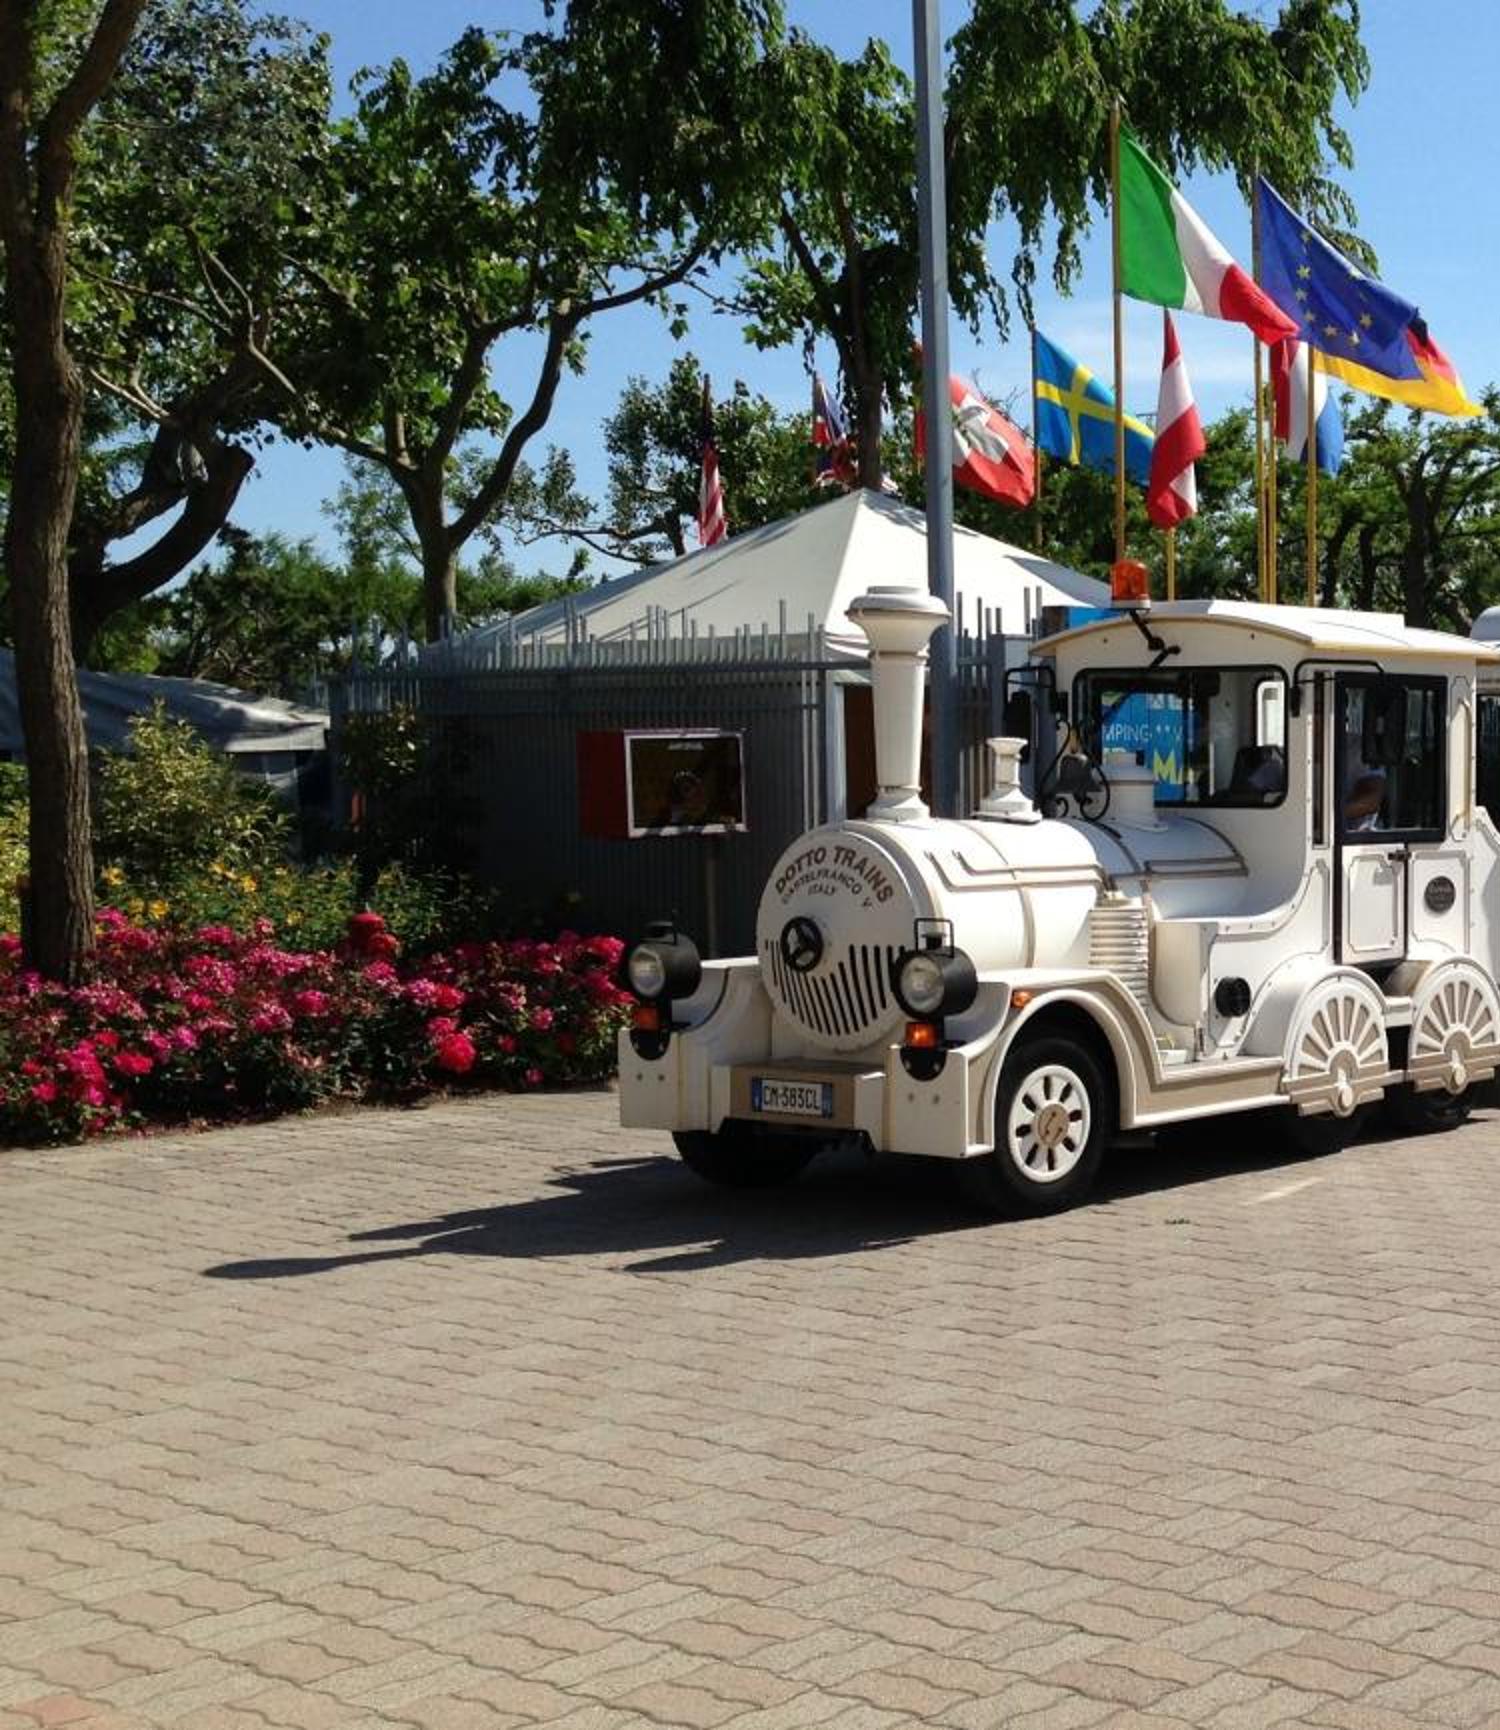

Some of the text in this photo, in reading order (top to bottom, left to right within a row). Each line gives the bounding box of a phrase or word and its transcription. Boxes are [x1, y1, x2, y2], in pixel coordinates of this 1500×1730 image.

[775, 845, 894, 903] DOTTO TRAINS
[781, 867, 863, 905] CASTELFRANCO
[807, 883, 837, 896] ITALY
